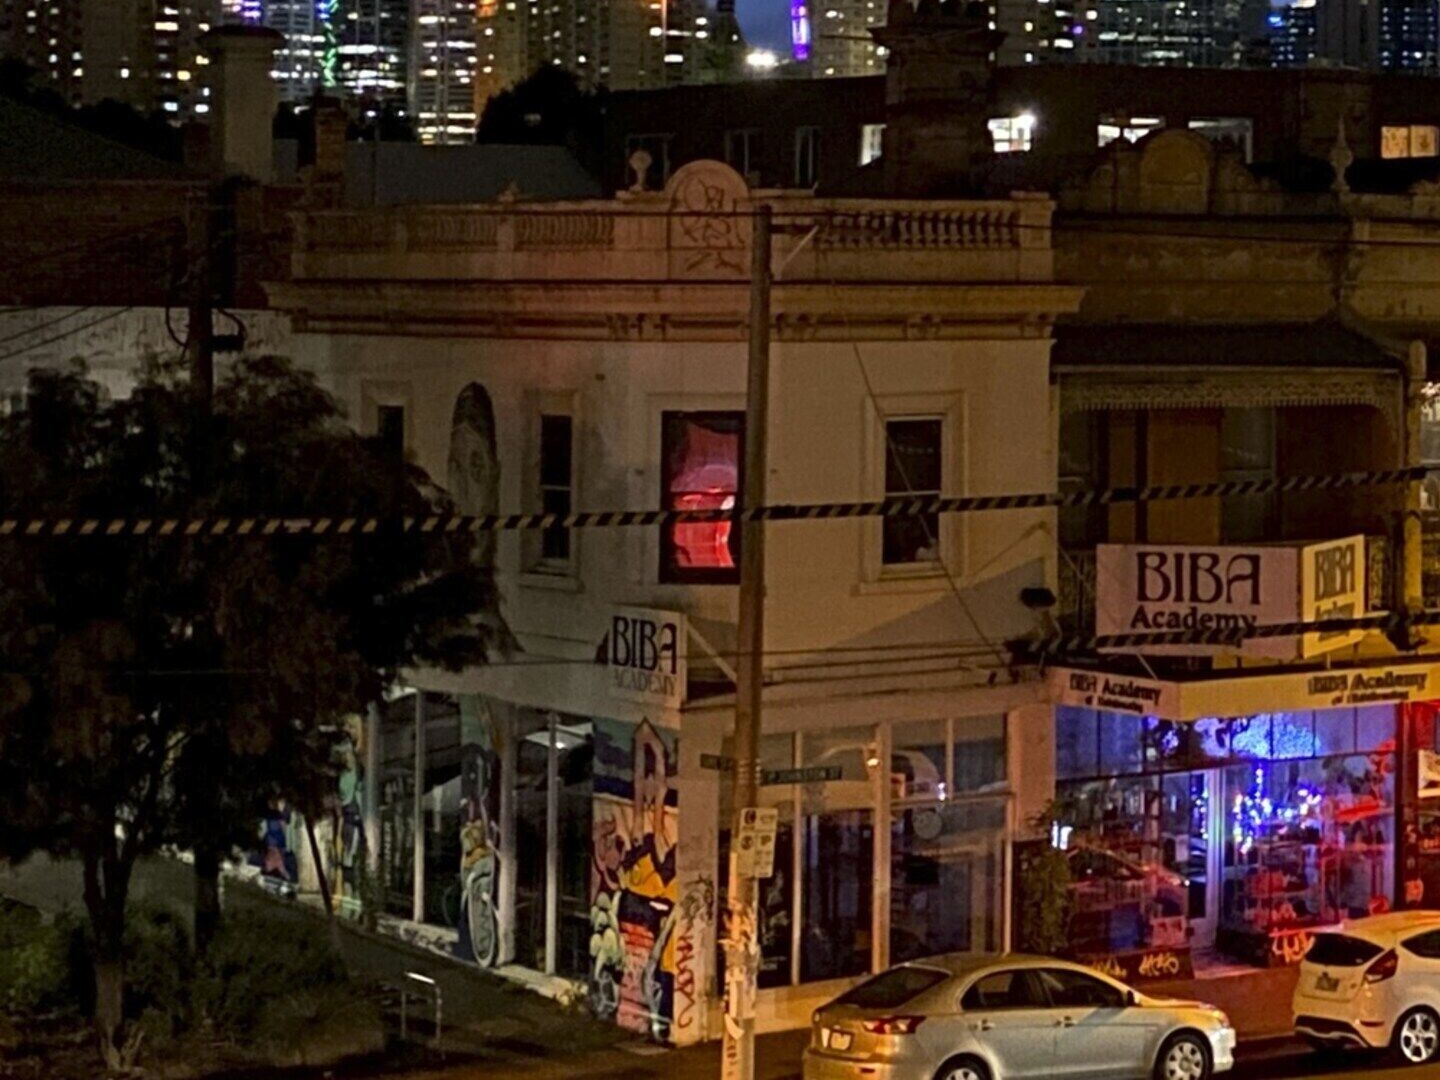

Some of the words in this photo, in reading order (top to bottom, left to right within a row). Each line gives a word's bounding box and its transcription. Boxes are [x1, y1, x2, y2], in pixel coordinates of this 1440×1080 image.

[1136, 551, 1261, 605] BIBA
[1314, 543, 1355, 602] BIBA
[1130, 604, 1257, 638] Academy
[612, 615, 678, 676] BIBA
[1102, 677, 1161, 707] Academy
[1351, 671, 1428, 692] Academy
